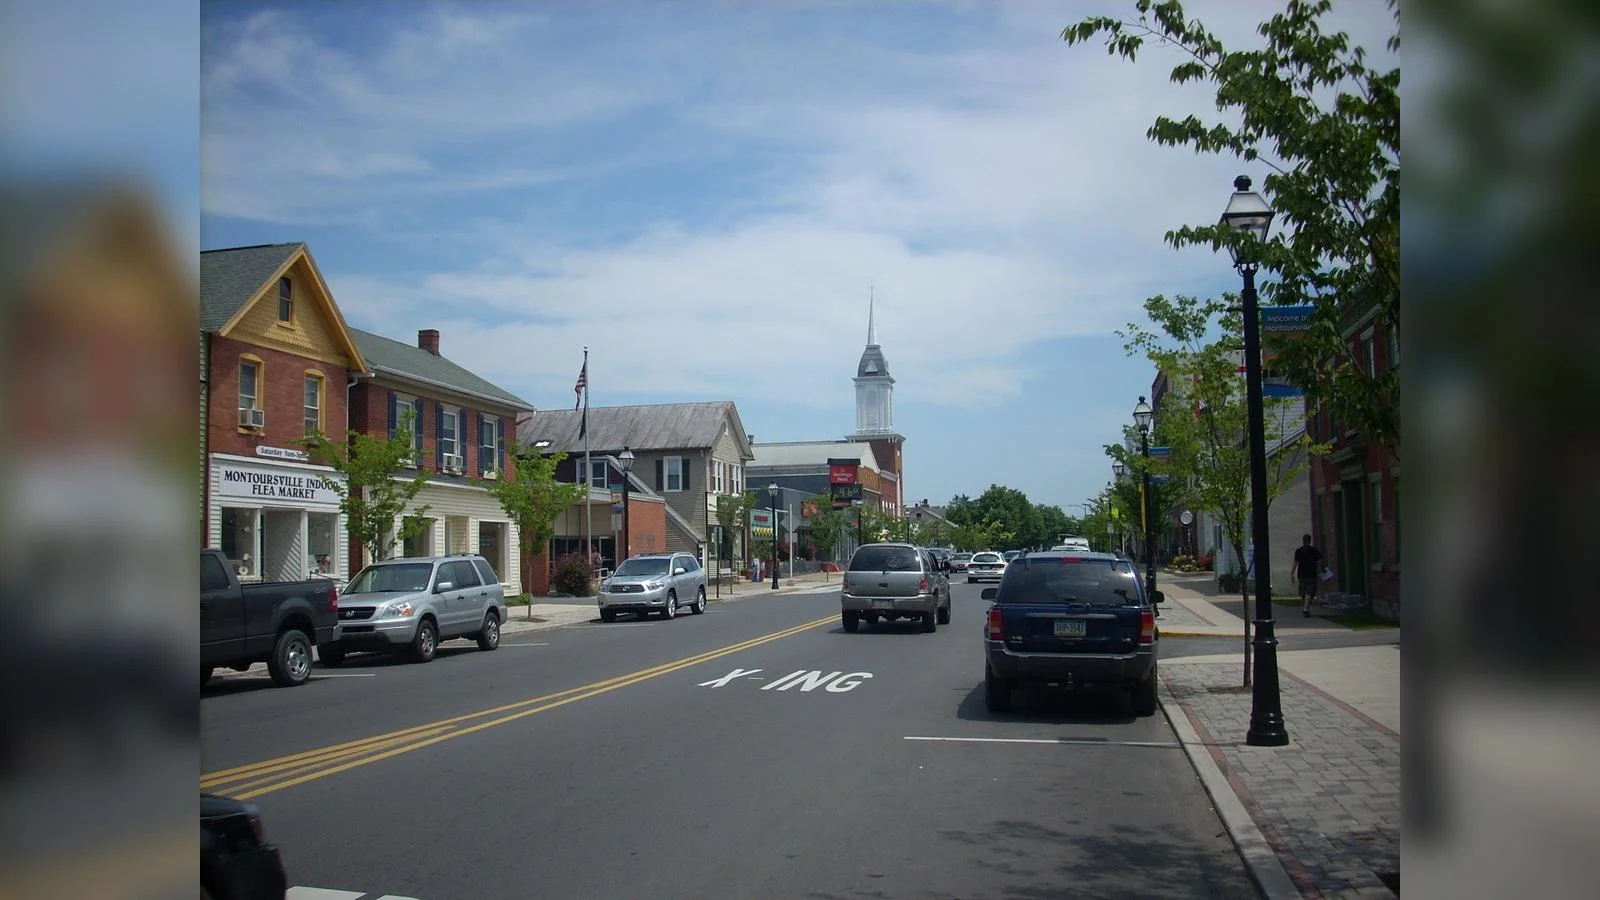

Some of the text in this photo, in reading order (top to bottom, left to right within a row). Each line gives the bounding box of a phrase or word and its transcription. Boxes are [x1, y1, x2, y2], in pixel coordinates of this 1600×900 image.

[260, 446, 282, 458] Saturday
[224, 470, 303, 488] MONTOURSVILLE
[252, 484, 316, 499] FLEA MARKET
